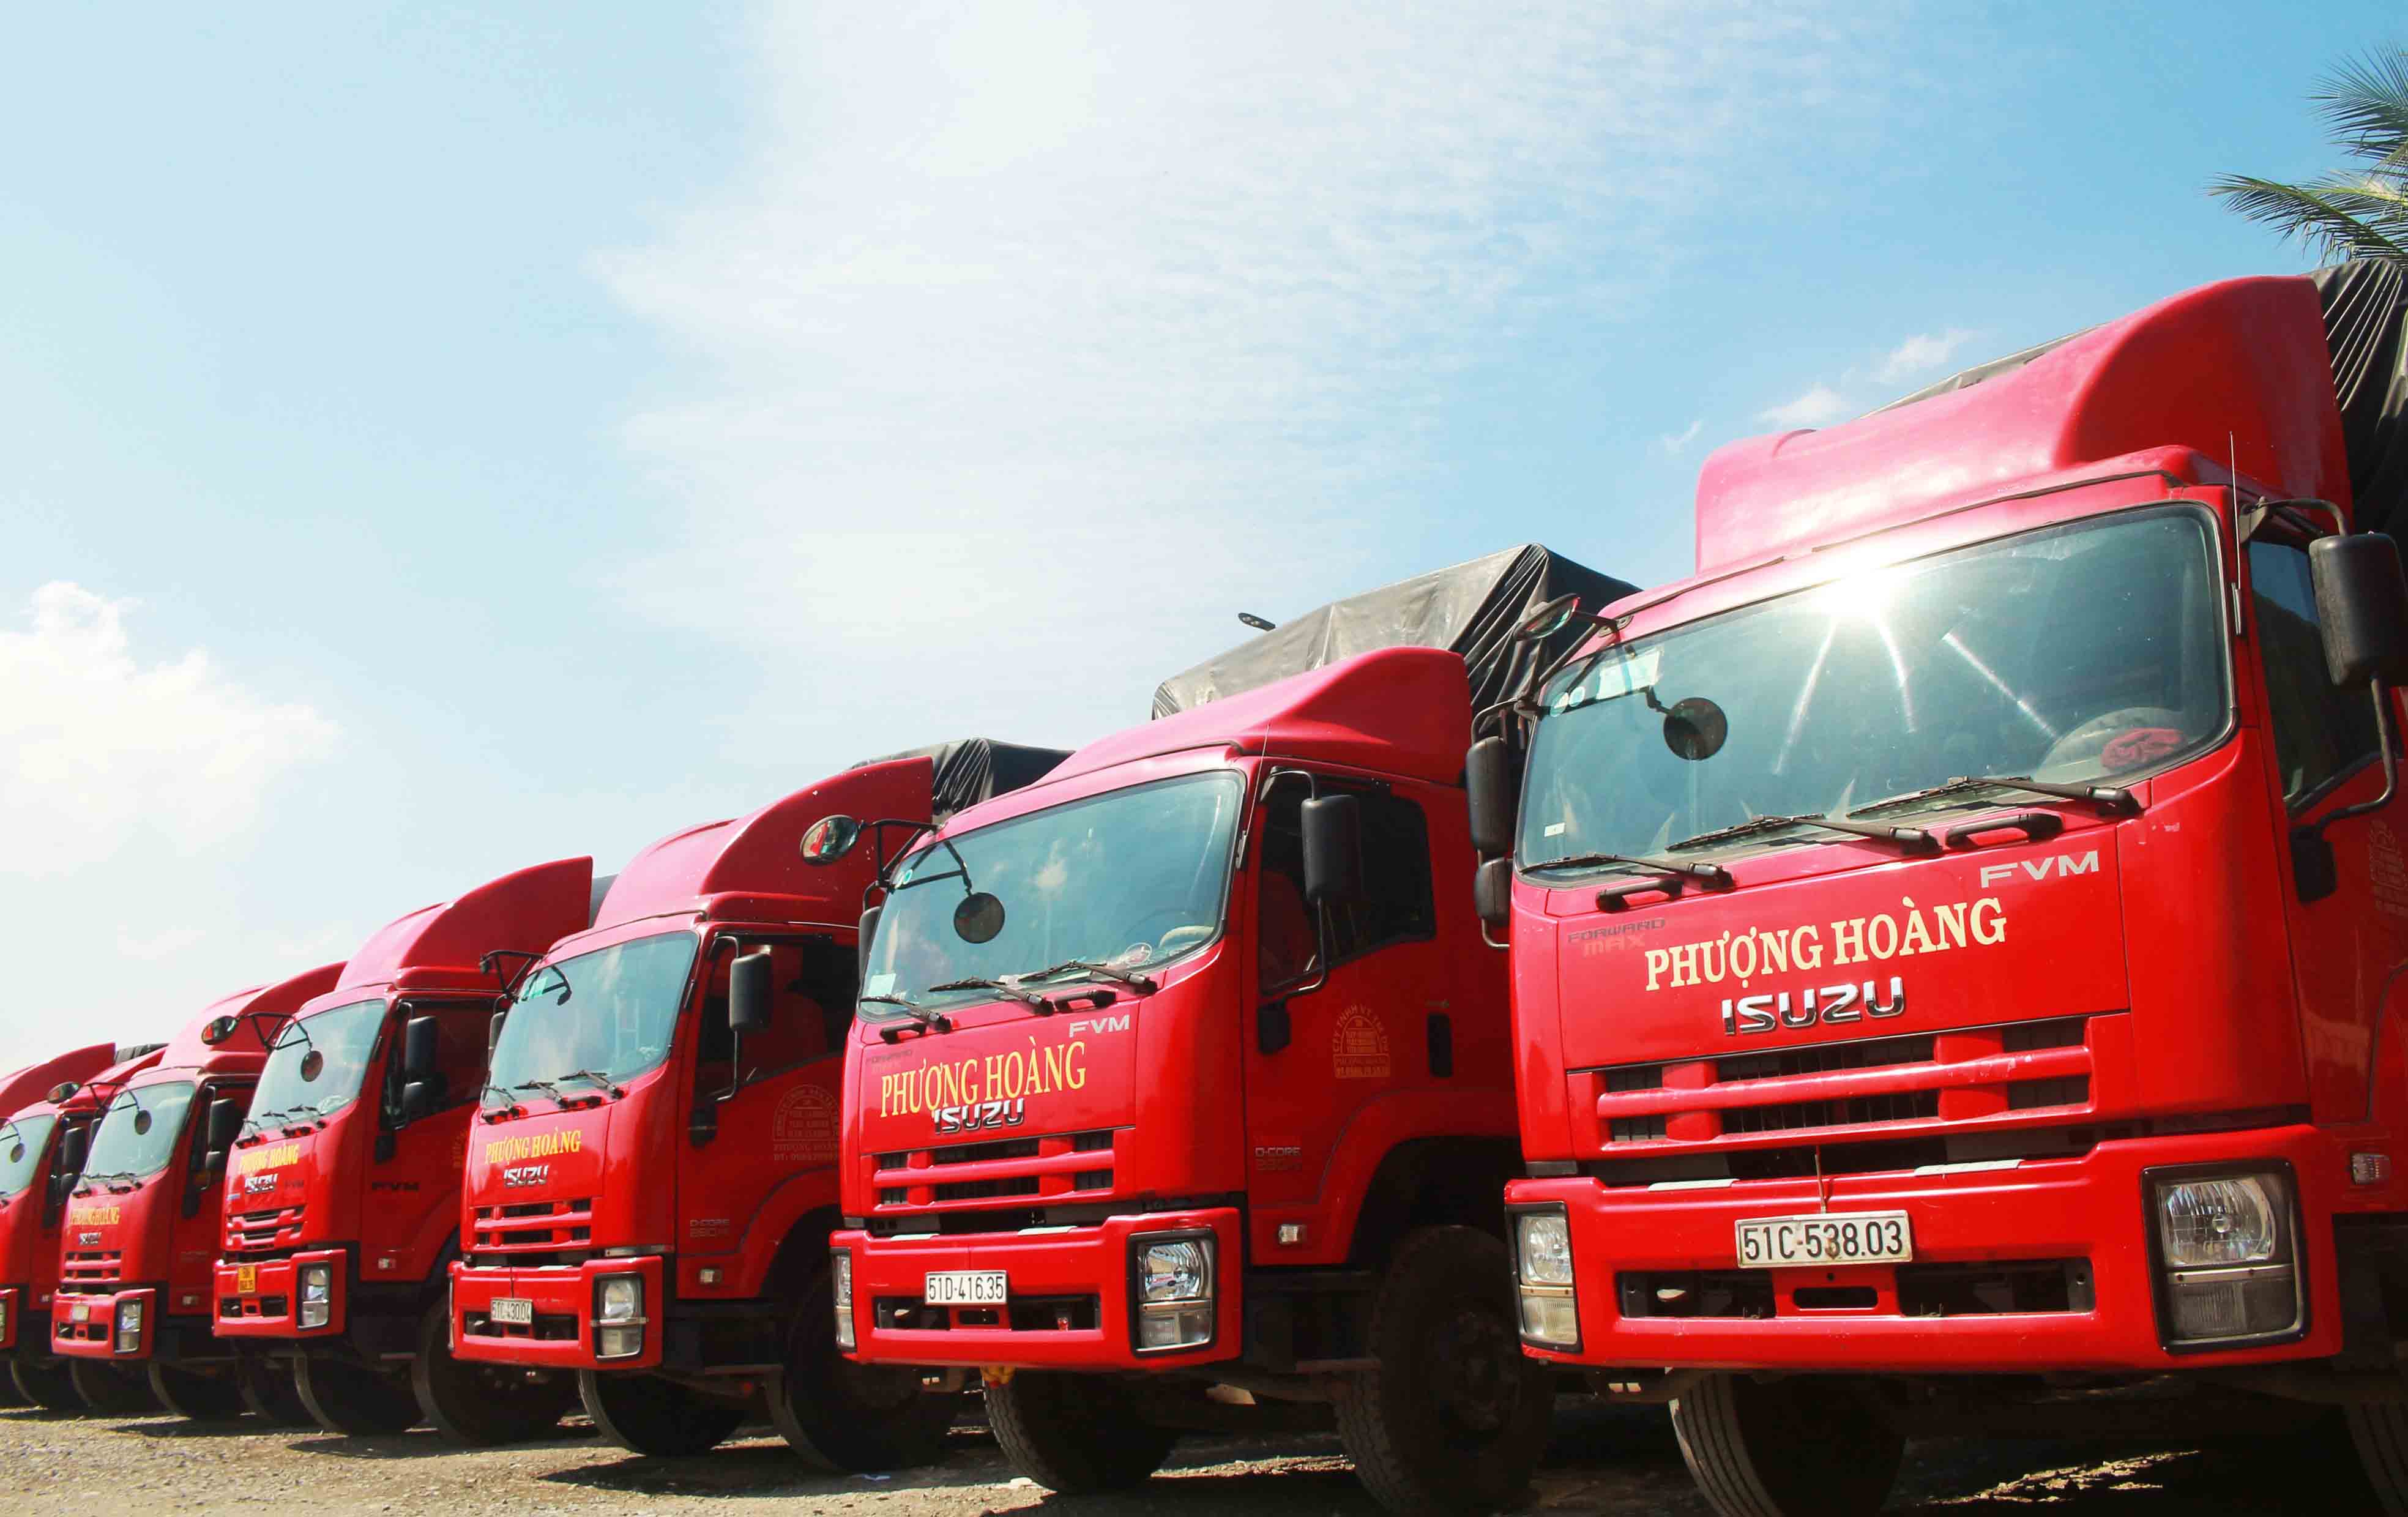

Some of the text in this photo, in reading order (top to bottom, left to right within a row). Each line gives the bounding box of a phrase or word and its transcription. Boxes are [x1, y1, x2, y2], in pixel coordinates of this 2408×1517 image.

[1980, 849, 2099, 888] FVM
[1568, 918, 1665, 944] FORWARD
[1646, 895, 2007, 991] PHƯỢNG HOÀNG
[1721, 976, 1905, 1035] ISUZU
[1068, 1014, 1130, 1038] FVM
[881, 1036, 1086, 1119] PHƯỢNG HOÀNG
[934, 1098, 1025, 1134] ISUZU
[531, 1126, 583, 1158] HOÀNG
[503, 1165, 550, 1188] ISUZU
[1743, 1220, 1903, 1261] 51C-538.03
